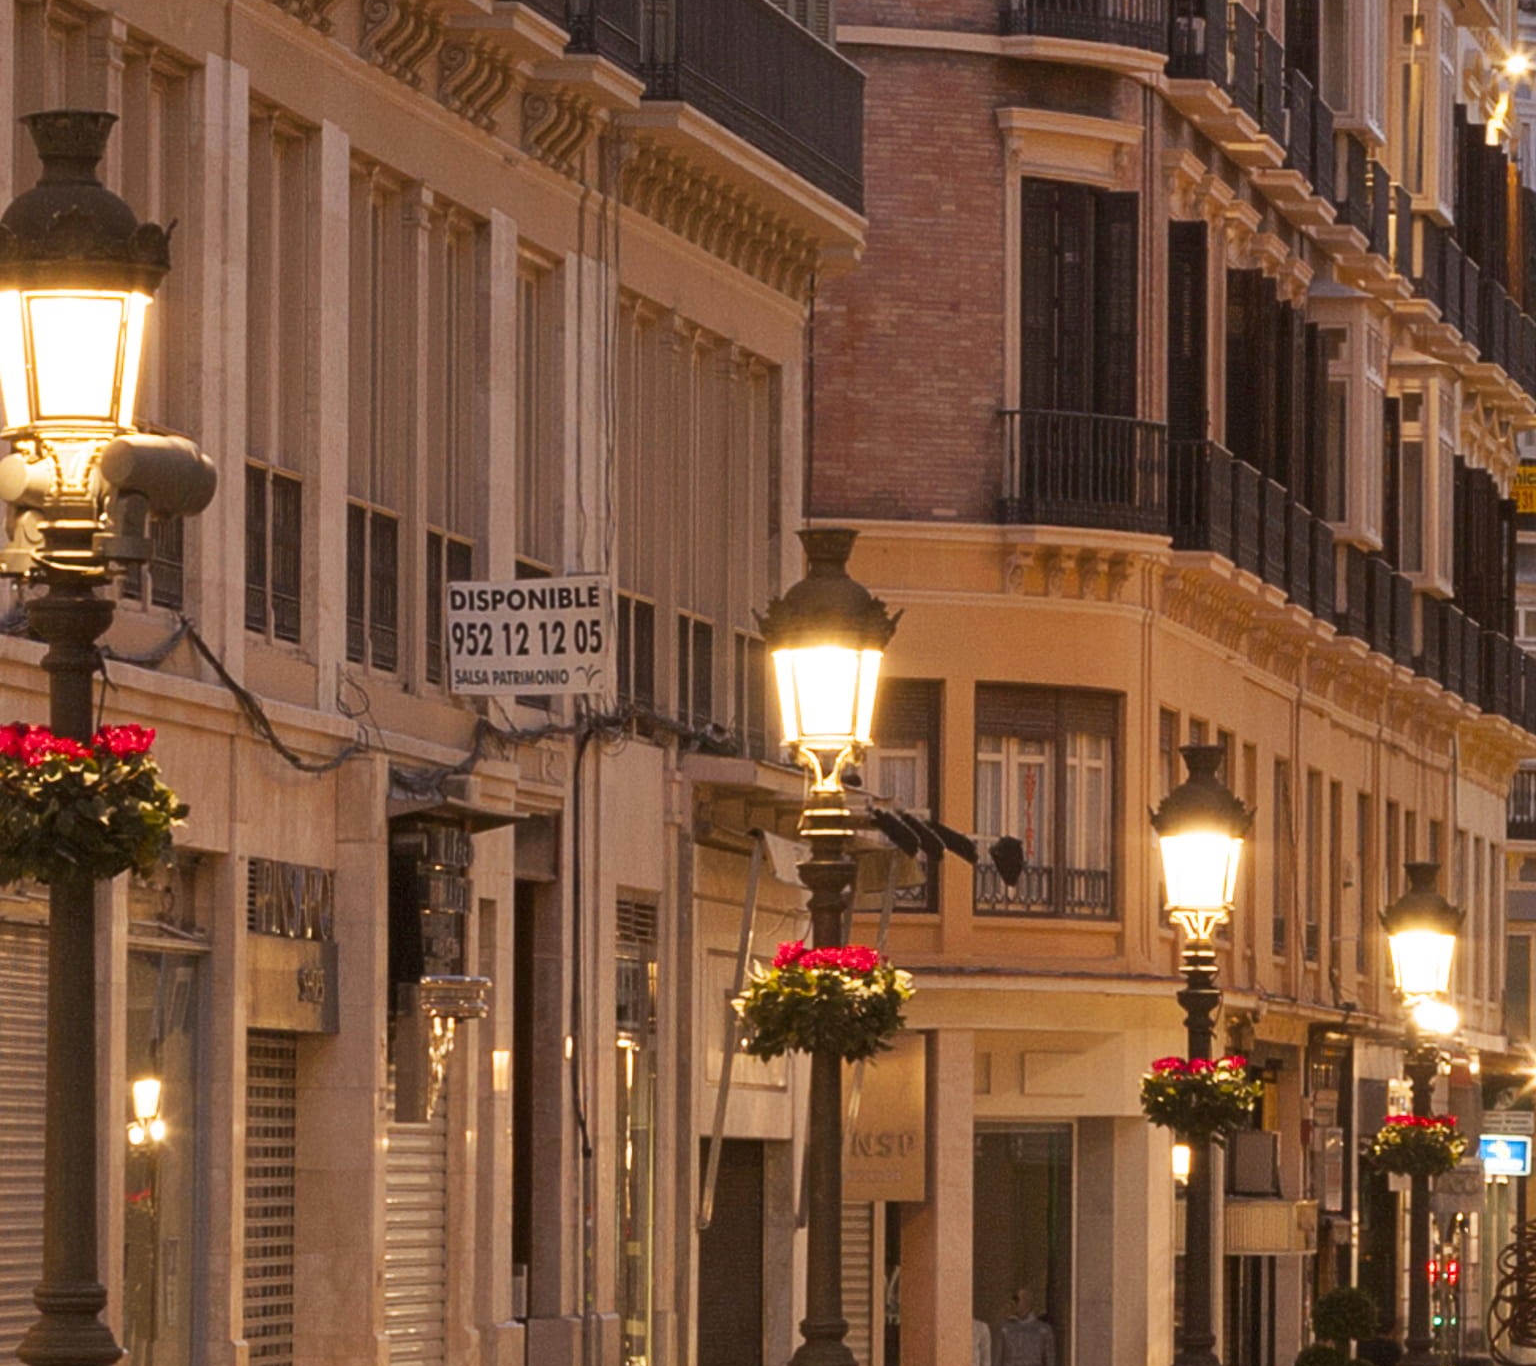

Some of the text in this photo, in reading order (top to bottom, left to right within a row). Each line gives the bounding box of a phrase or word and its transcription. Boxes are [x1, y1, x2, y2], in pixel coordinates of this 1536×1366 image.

[450, 586, 600, 612] DISPONIBLE
[452, 619, 603, 656] 952 12 12 05
[454, 667, 570, 685] SALSA PATRIMONIO
